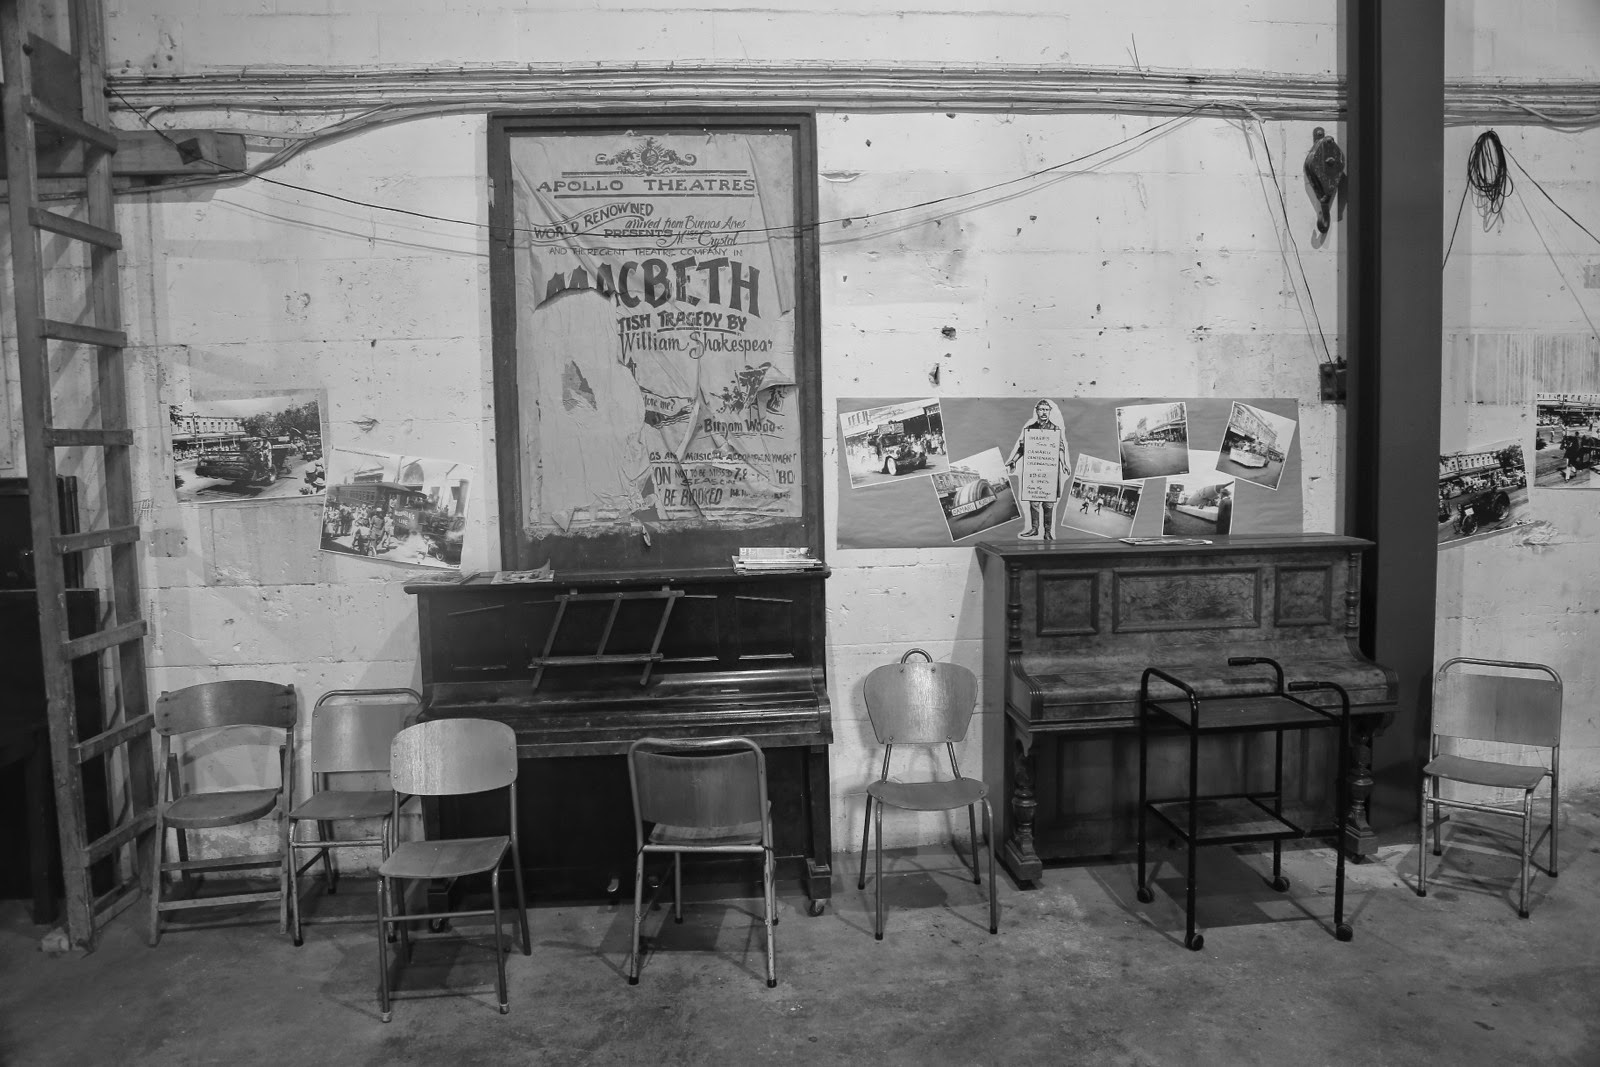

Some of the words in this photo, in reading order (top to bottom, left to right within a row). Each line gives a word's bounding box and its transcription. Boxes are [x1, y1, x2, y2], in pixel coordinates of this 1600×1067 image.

[536, 179, 624, 193] APOLLO
[643, 178, 756, 192] THEATRES
[584, 202, 654, 227] RENOWNED
[625, 217, 661, 229] arrived
[662, 217, 683, 233] from
[685, 215, 721, 230] Buenos
[721, 216, 747, 229] Aires
[603, 228, 674, 238] PRESENTS
[698, 230, 739, 251] Crystal
[549, 247, 567, 256] AND
[587, 248, 625, 256] REGENT
[680, 247, 728, 256] COMPANY
[733, 248, 743, 257] IN
[657, 310, 723, 327] TRAGEDY
[726, 313, 748, 332] BY
[617, 331, 690, 365] William
